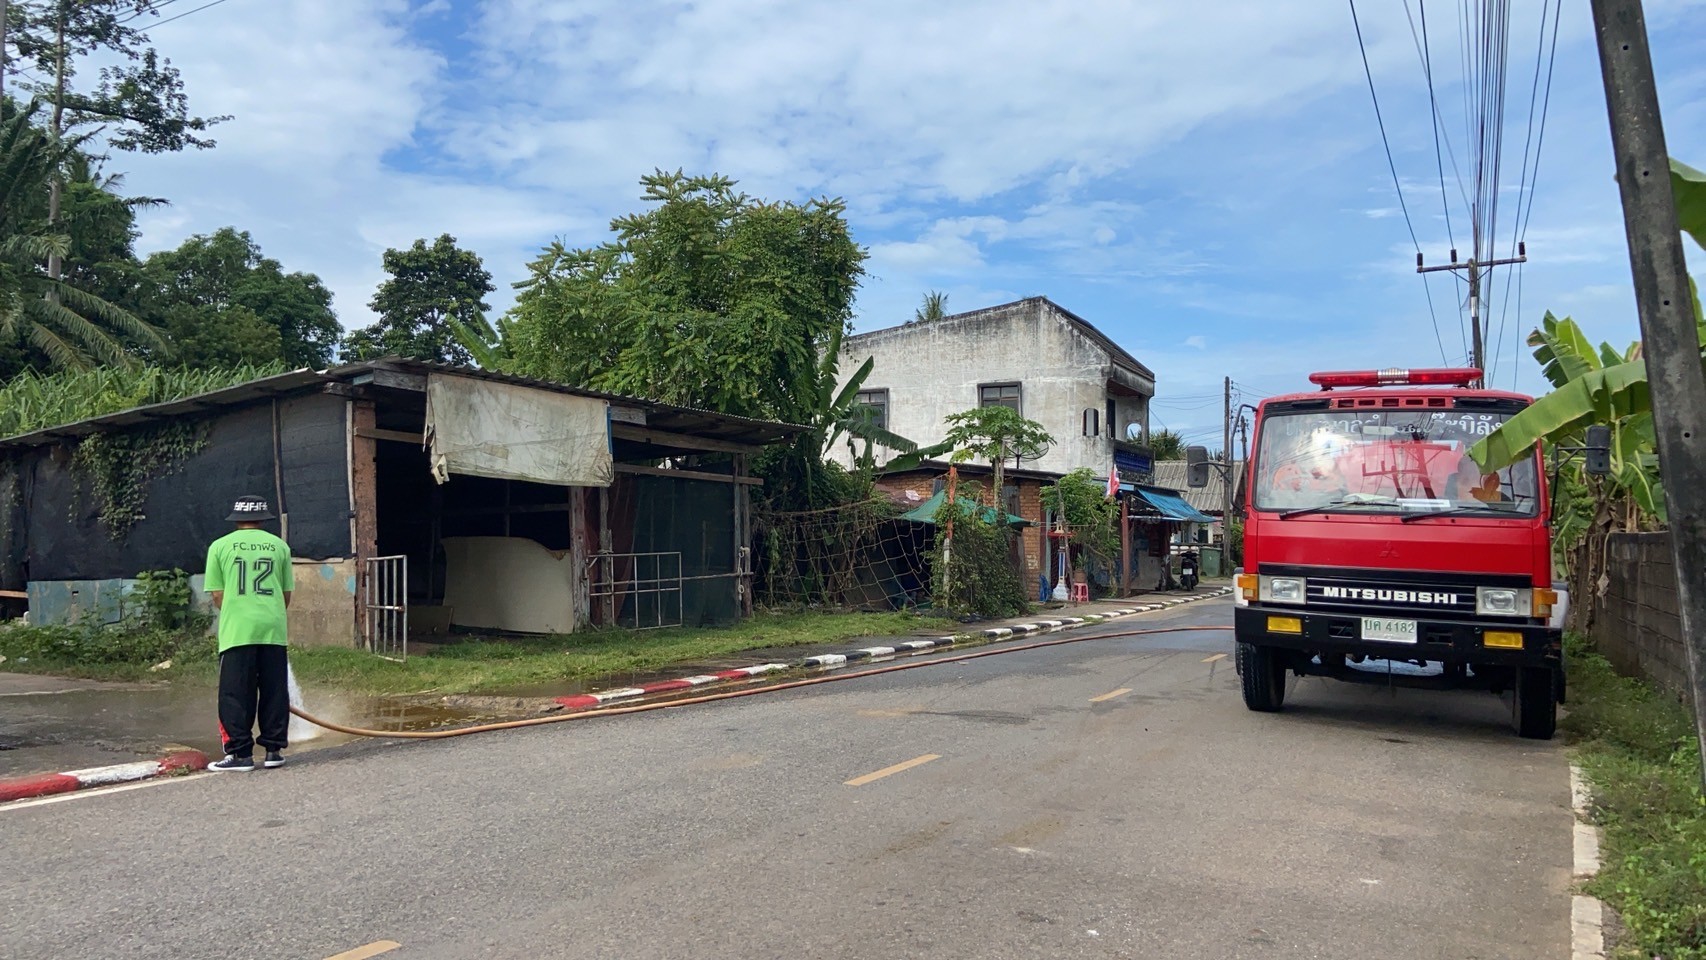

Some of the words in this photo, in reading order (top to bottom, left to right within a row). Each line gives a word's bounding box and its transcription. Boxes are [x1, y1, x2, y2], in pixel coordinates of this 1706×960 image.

[234, 556, 274, 596] 12
[1323, 586, 1457, 604] MITSUBISHI
[1385, 621, 1415, 633] 4182
